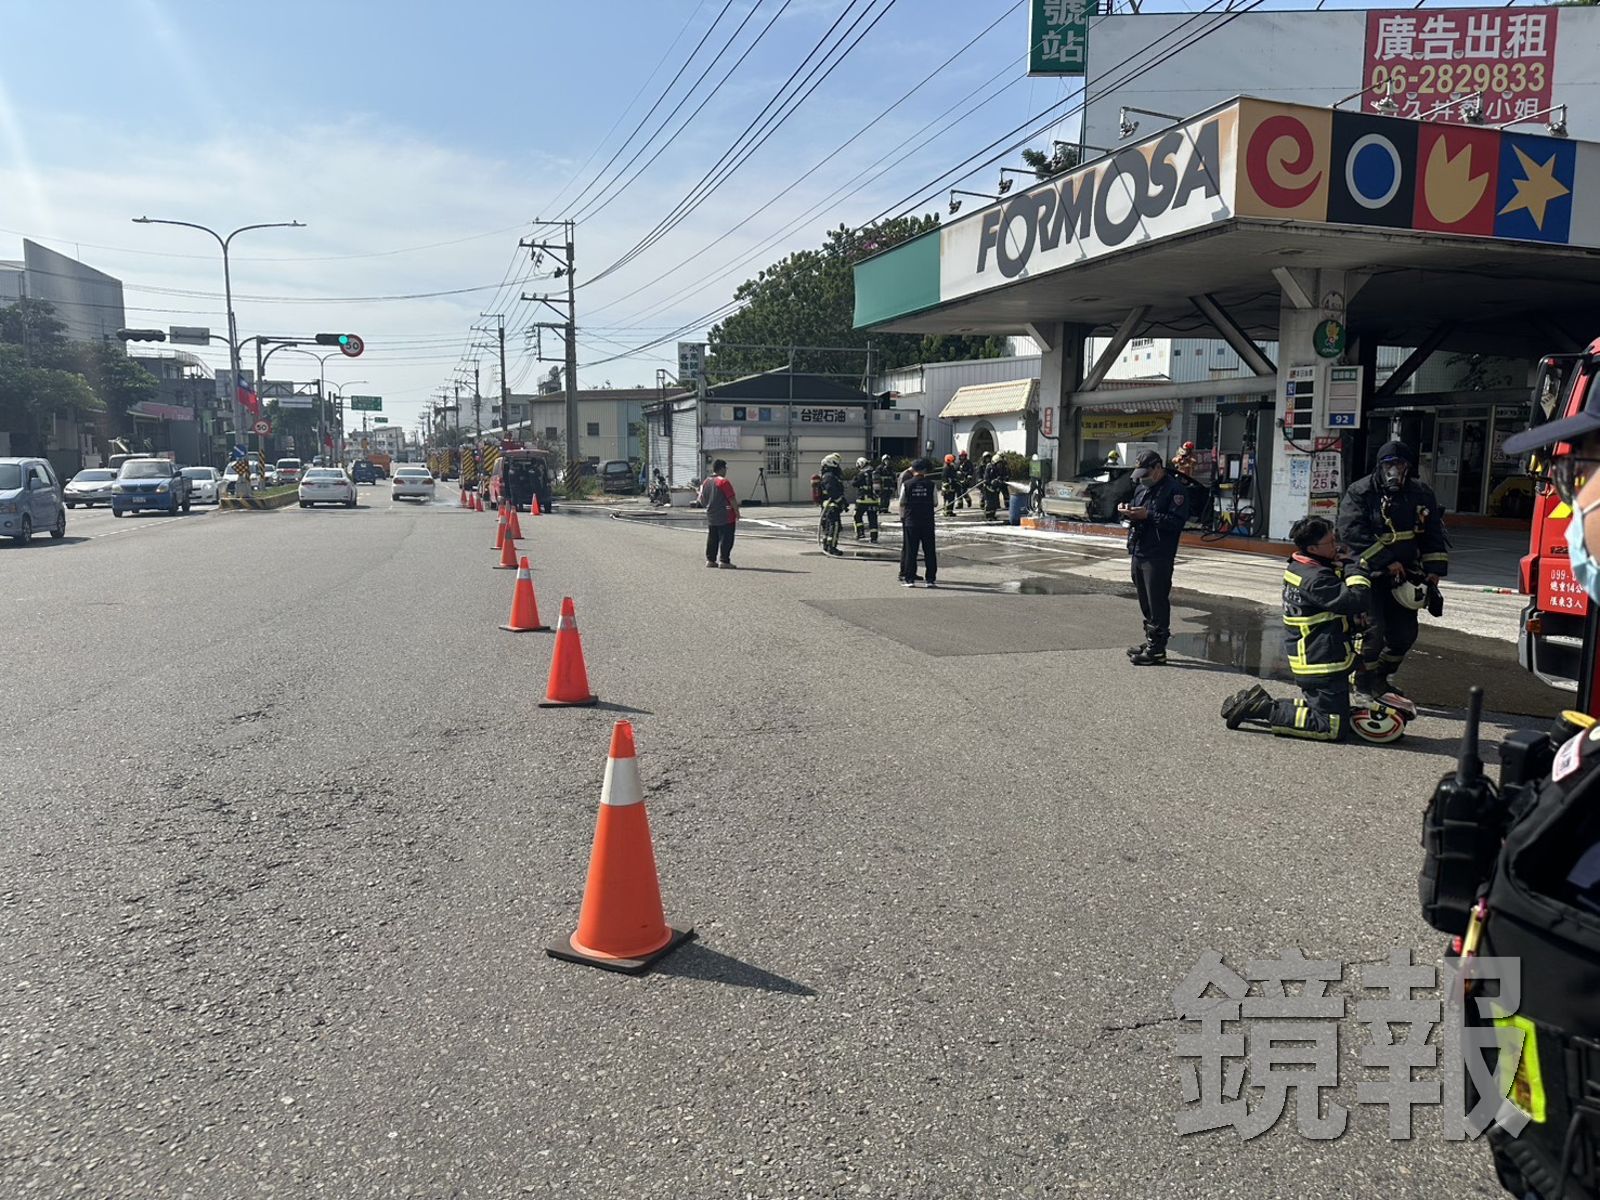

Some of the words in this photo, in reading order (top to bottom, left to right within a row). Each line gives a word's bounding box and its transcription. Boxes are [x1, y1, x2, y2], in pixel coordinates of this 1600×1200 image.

[1042, 0, 1086, 62] 號站
[1374, 13, 1548, 61] 廣告出租
[1371, 62, 1545, 95] 06-2829833
[976, 119, 1221, 278] FORMOSA
[256, 423, 267, 431] 50
[801, 408, 846, 423] 台塑石油
[1335, 415, 1349, 424] 92
